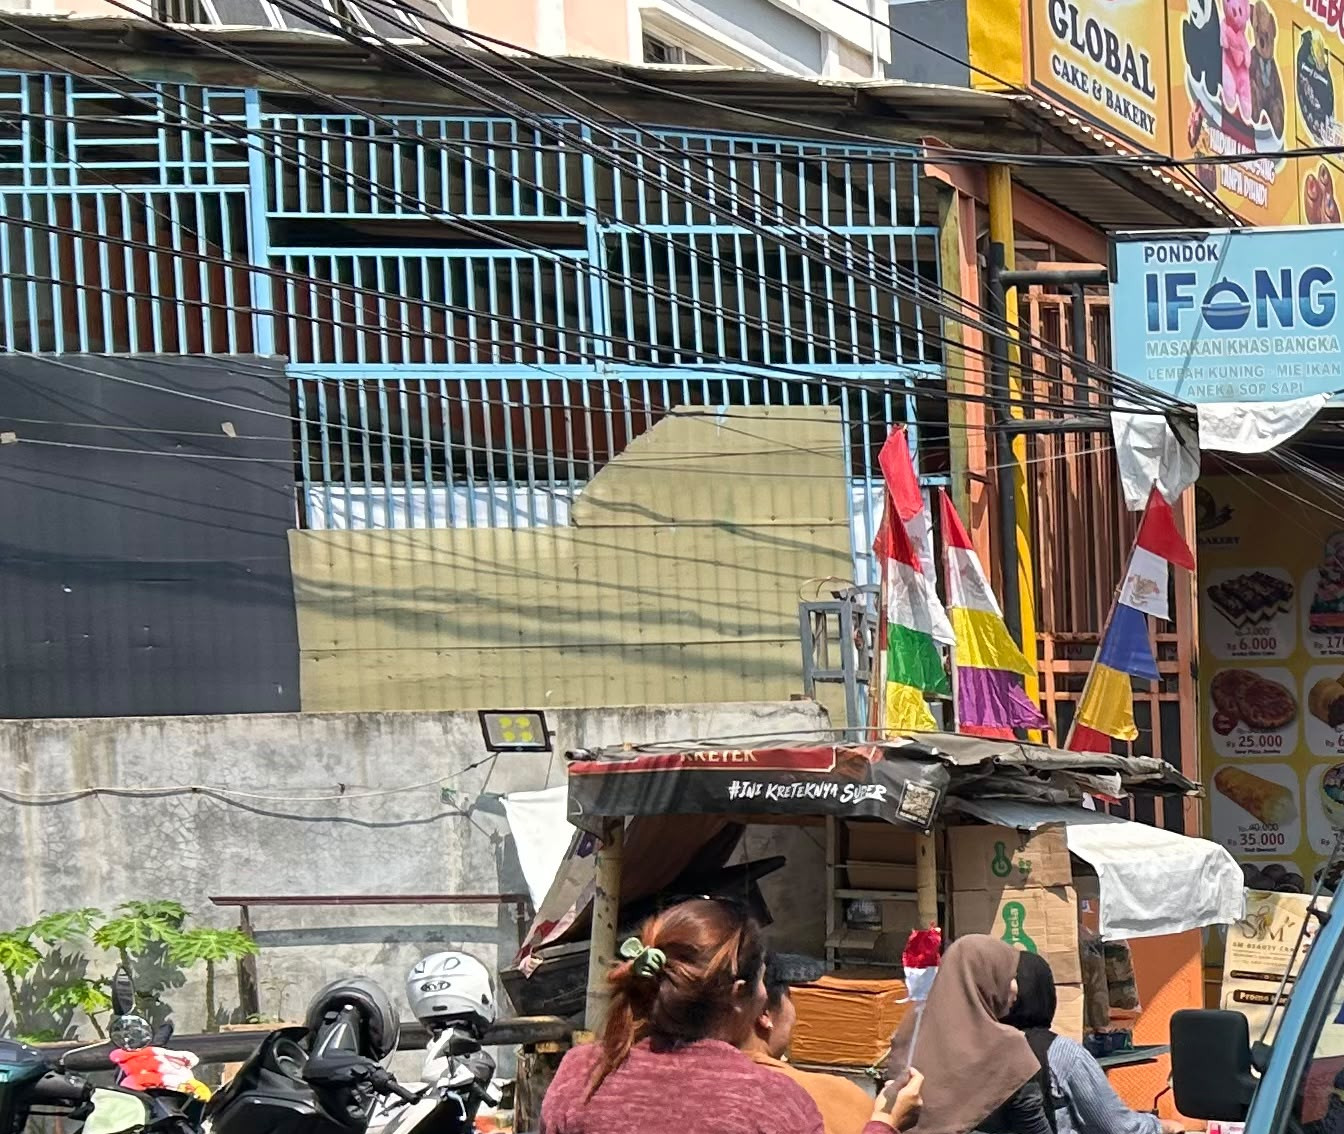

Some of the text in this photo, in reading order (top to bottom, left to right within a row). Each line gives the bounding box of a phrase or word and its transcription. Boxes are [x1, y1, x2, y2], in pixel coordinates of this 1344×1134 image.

[1049, 0, 1156, 99] GLOBAL
[1052, 54, 1156, 136] CAKE & BAKERY
[1144, 244, 1219, 263] PONDOK
[1147, 335, 1340, 357] MASAKAN KHAS BANGKA
[1148, 362, 1341, 381] LEMPAH KUNING MIE IKAN
[1187, 382, 1235, 397] ANEKA
[1239, 637, 1278, 650] 6.000
[1238, 735, 1283, 747] 25.000
[839, 784, 888, 804] SUPER
[1239, 832, 1285, 846] 35.000
